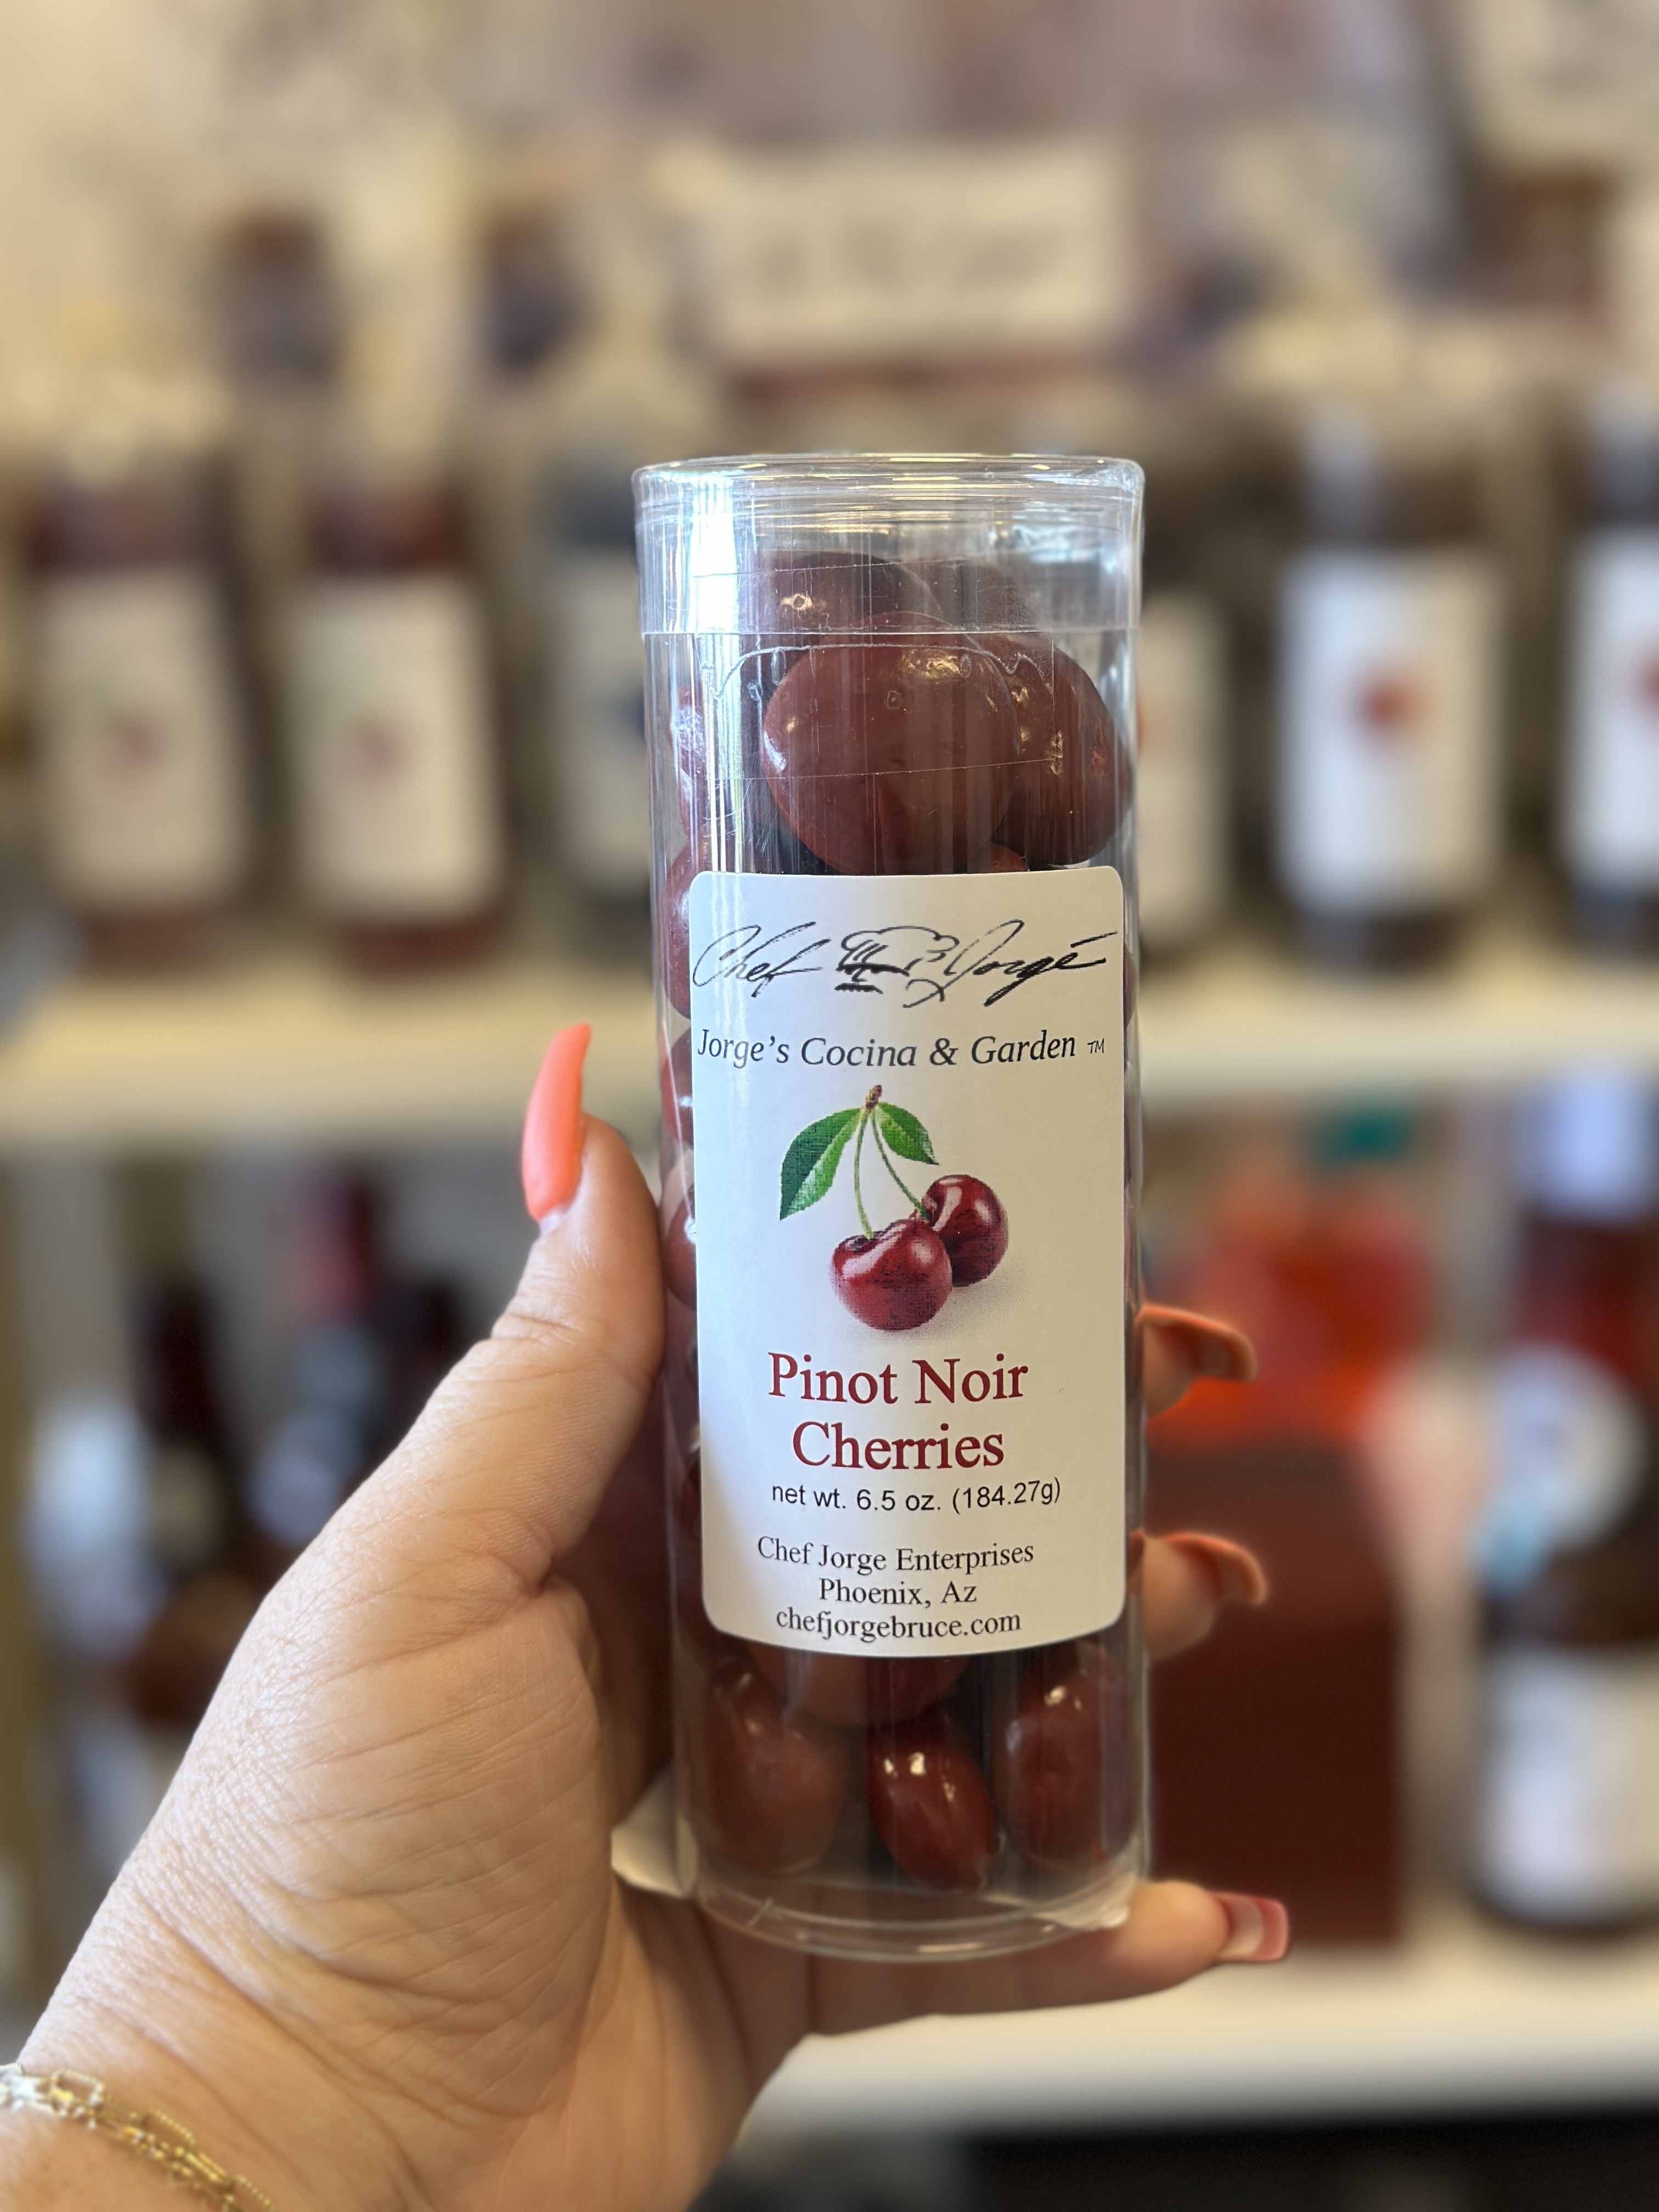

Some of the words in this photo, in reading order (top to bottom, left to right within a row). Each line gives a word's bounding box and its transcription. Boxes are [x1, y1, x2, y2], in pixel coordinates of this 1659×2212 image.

[693, 922, 831, 998] Chef
[698, 1029, 789, 1069] Jorge’s
[802, 1037, 916, 1066] Cocina
[929, 1038, 958, 1065] &
[972, 1029, 1076, 1064] Garden
[768, 1352, 898, 1404] Pinot
[912, 1353, 1028, 1403] Noir
[793, 1421, 1004, 1470] Cherries
[772, 1485, 806, 1505] net
[813, 1488, 846, 1509] wt.
[857, 1489, 895, 1511] 6.5
[905, 1495, 940, 1511] oz.
[953, 1477, 1060, 1515] (184.27g)
[758, 1536, 814, 1564] Chef
[818, 1545, 886, 1576] Jorge
[896, 1543, 1034, 1575] Enterprises
[820, 1578, 931, 1609] Phoenix,
[941, 1581, 977, 1603] Az
[777, 1608, 1021, 1643] chefjorgebruce.com
